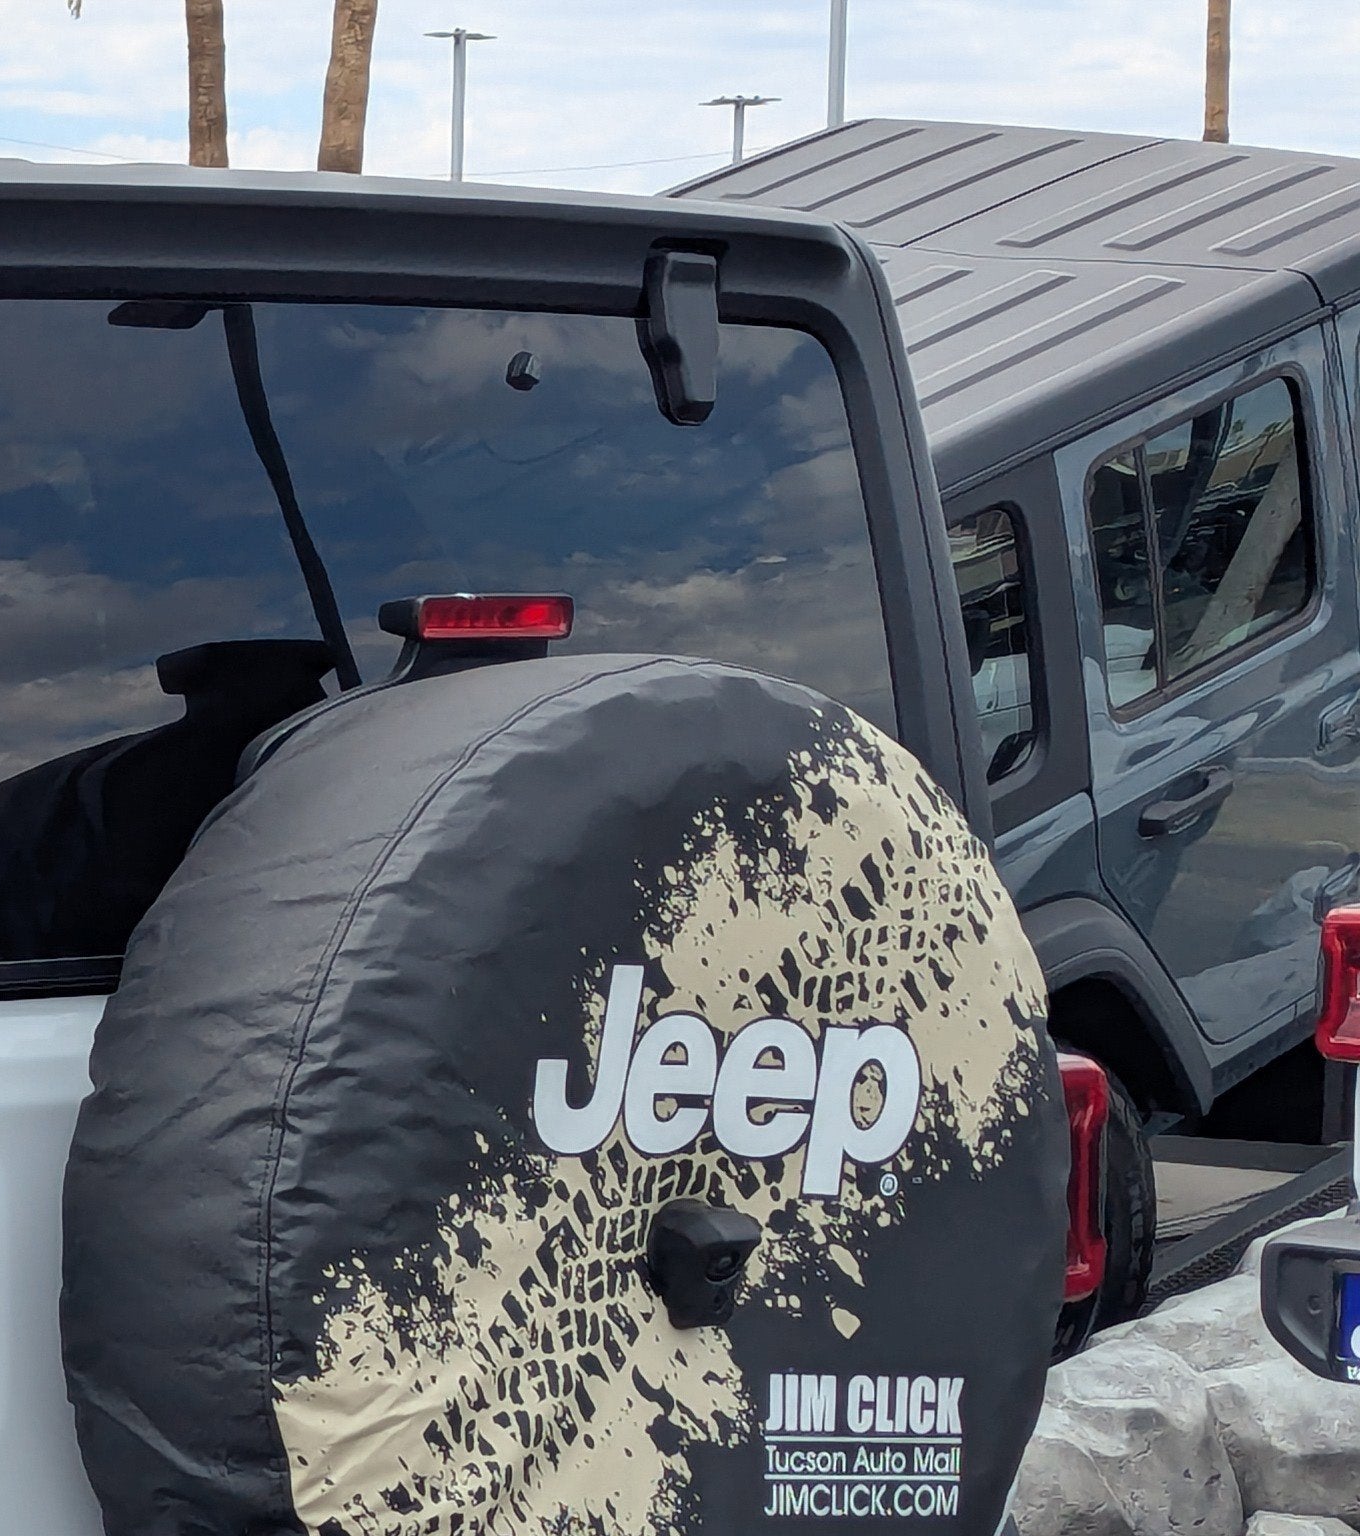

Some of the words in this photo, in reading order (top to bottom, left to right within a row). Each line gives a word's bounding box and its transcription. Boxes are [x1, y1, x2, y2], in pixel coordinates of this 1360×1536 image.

[533, 964, 921, 1196] Jeep
[765, 1373, 837, 1432] JIM
[847, 1374, 964, 1434] CLICK
[765, 1444, 847, 1473] Tucson
[853, 1445, 907, 1473] Auto
[913, 1446, 961, 1474] Mall
[764, 1483, 959, 1517] JIMCLICK.COM
